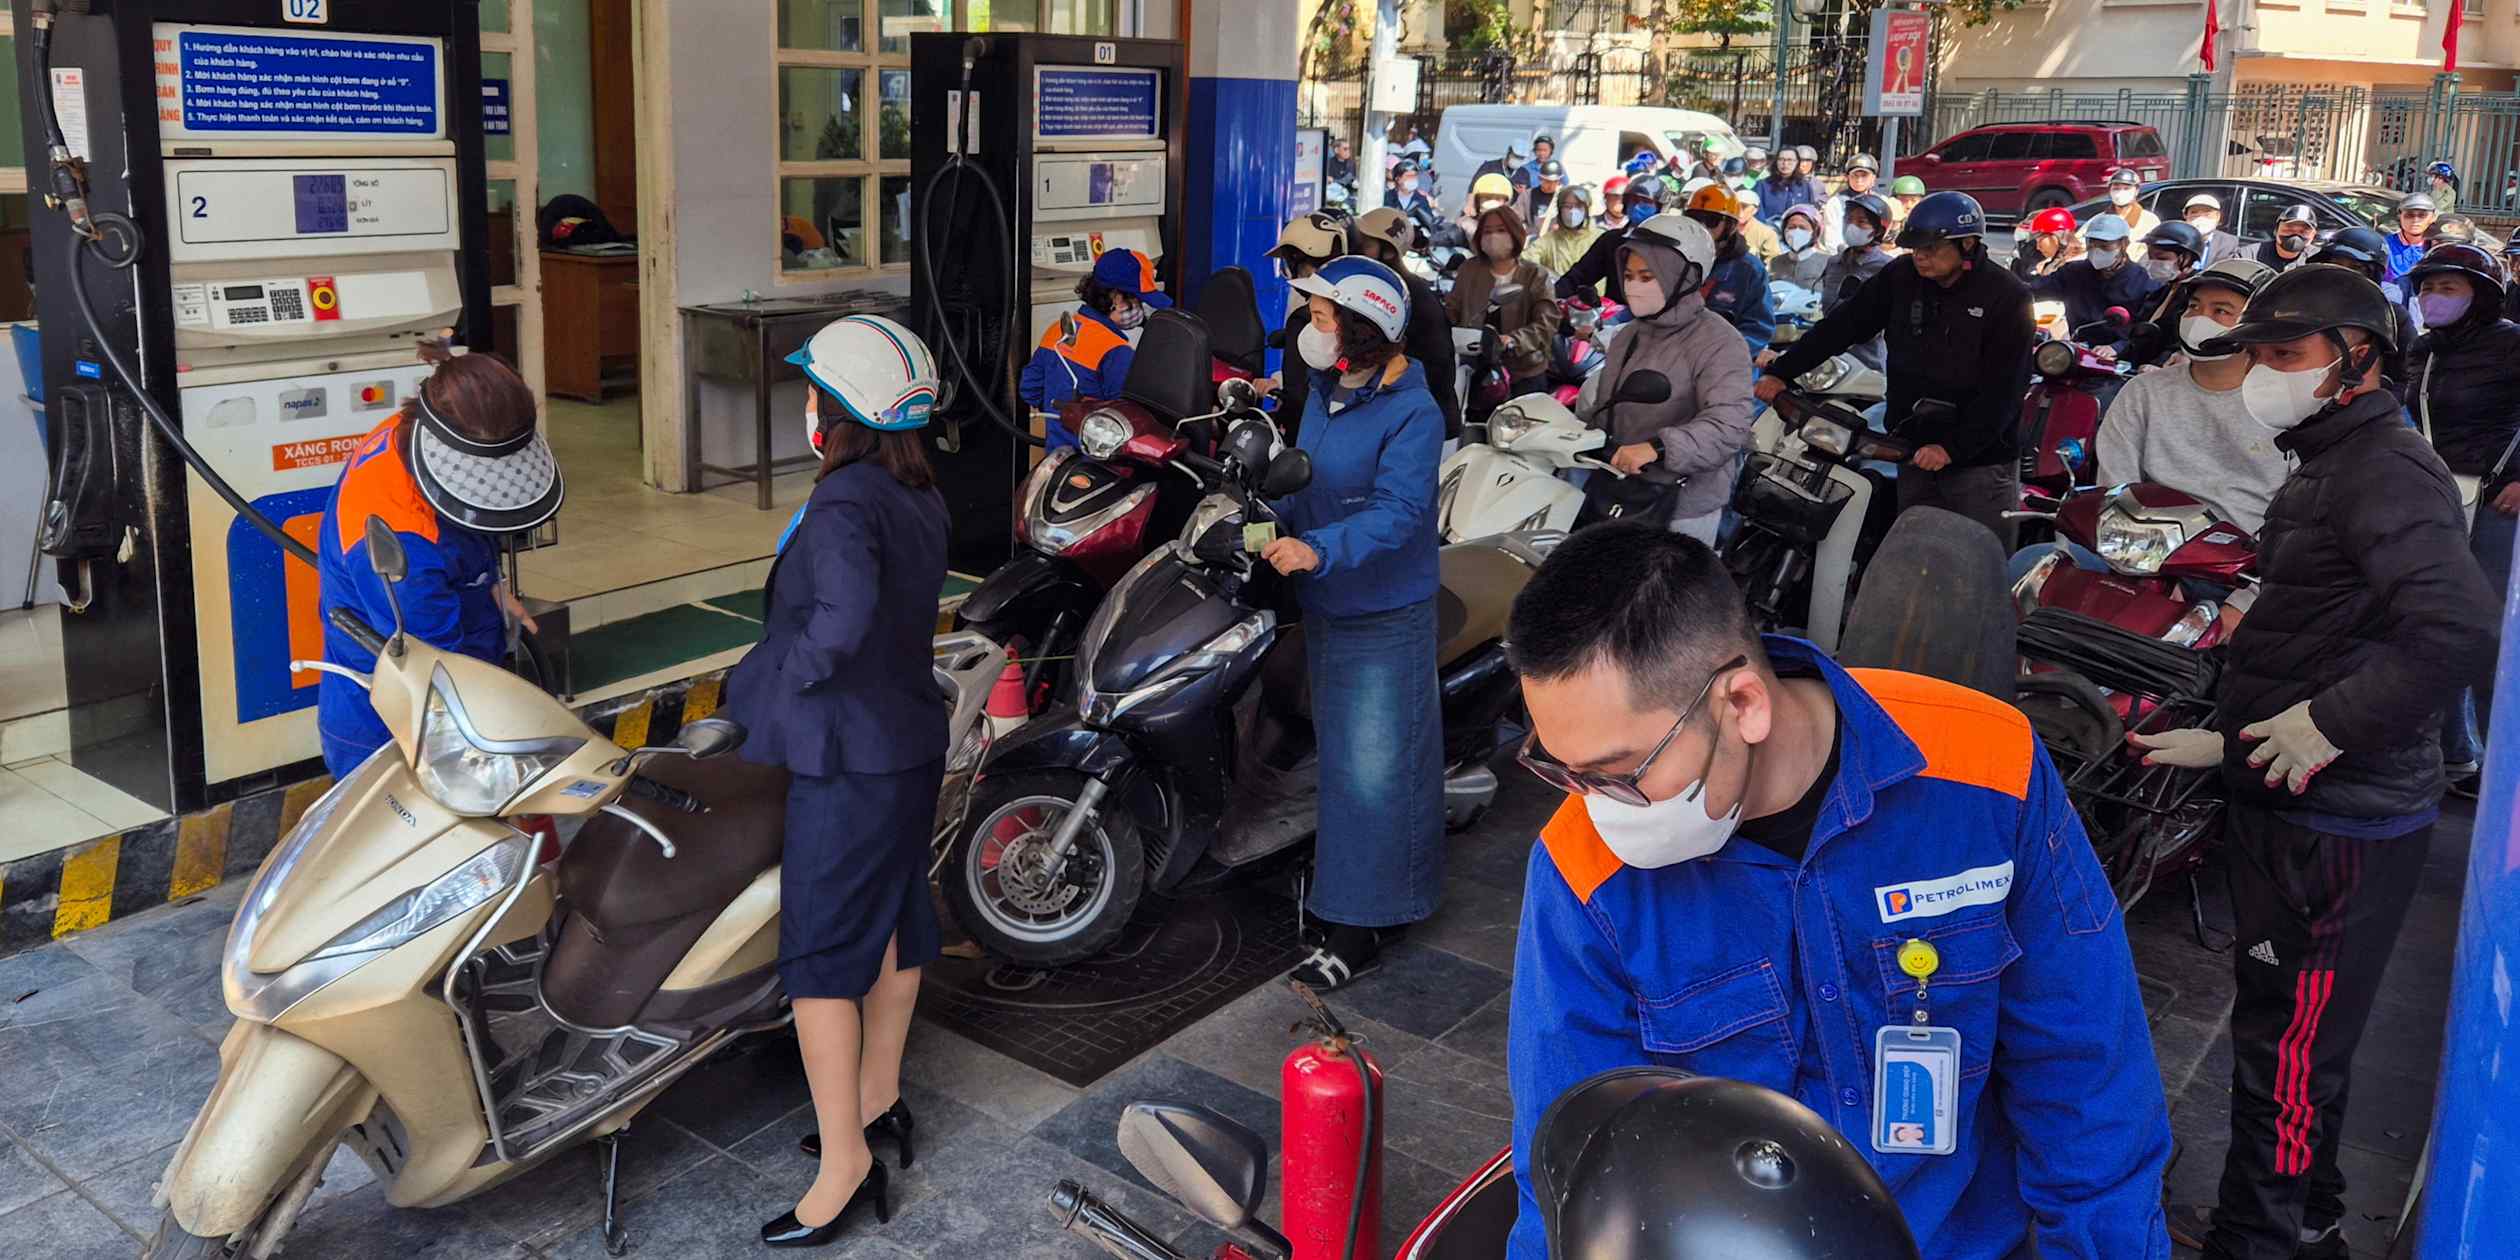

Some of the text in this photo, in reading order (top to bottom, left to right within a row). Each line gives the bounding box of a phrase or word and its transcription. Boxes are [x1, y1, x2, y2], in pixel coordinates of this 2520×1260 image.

[290, 0, 320, 18] 02
[239, 44, 263, 54] khách
[265, 45, 284, 56] hàng
[1100, 46, 1111, 60] 01
[210, 57, 234, 67] khách
[185, 70, 193, 79] 2.
[212, 70, 236, 81] khách
[237, 72, 257, 83] hàng
[216, 86, 237, 96] hàng
[337, 88, 359, 97] khách
[186, 98, 194, 107] 4.
[213, 98, 237, 108] khách
[238, 99, 258, 110] hàng
[1044, 179, 1050, 192] 1
[191, 196, 208, 218] 2
[284, 399, 313, 411] napas
[1914, 874, 2011, 904] PETROLIMEX
